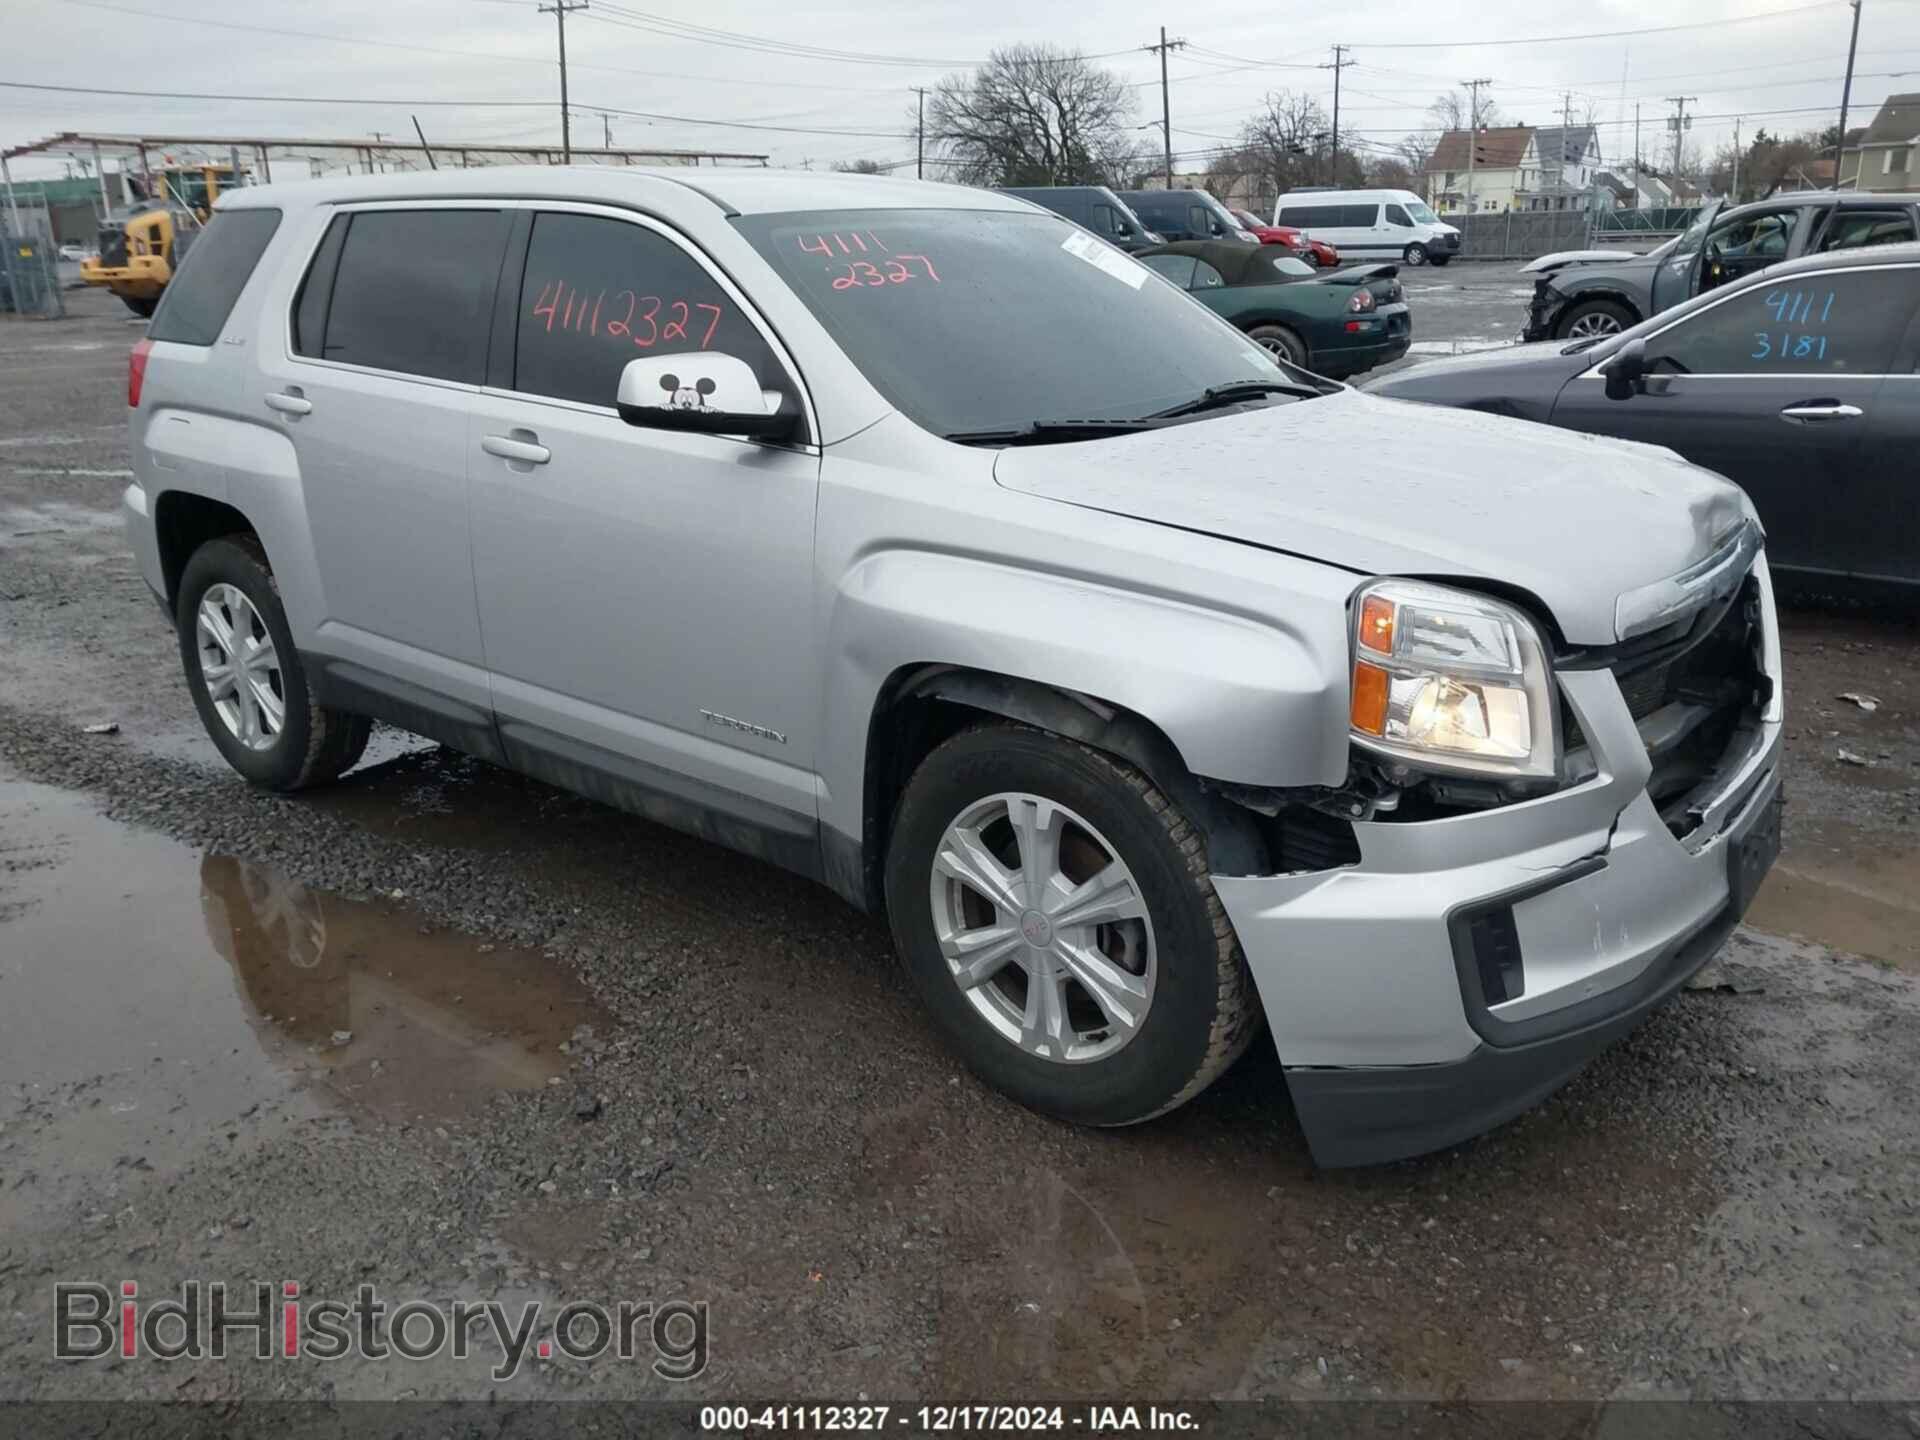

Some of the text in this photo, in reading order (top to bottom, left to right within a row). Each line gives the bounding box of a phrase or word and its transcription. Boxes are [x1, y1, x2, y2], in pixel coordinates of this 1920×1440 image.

[798, 231, 889, 257] 4111
[832, 254, 941, 290] 2327
[533, 279, 721, 350] 41112327
[1765, 290, 1835, 324] 4111
[1751, 332, 1827, 360] 3181
